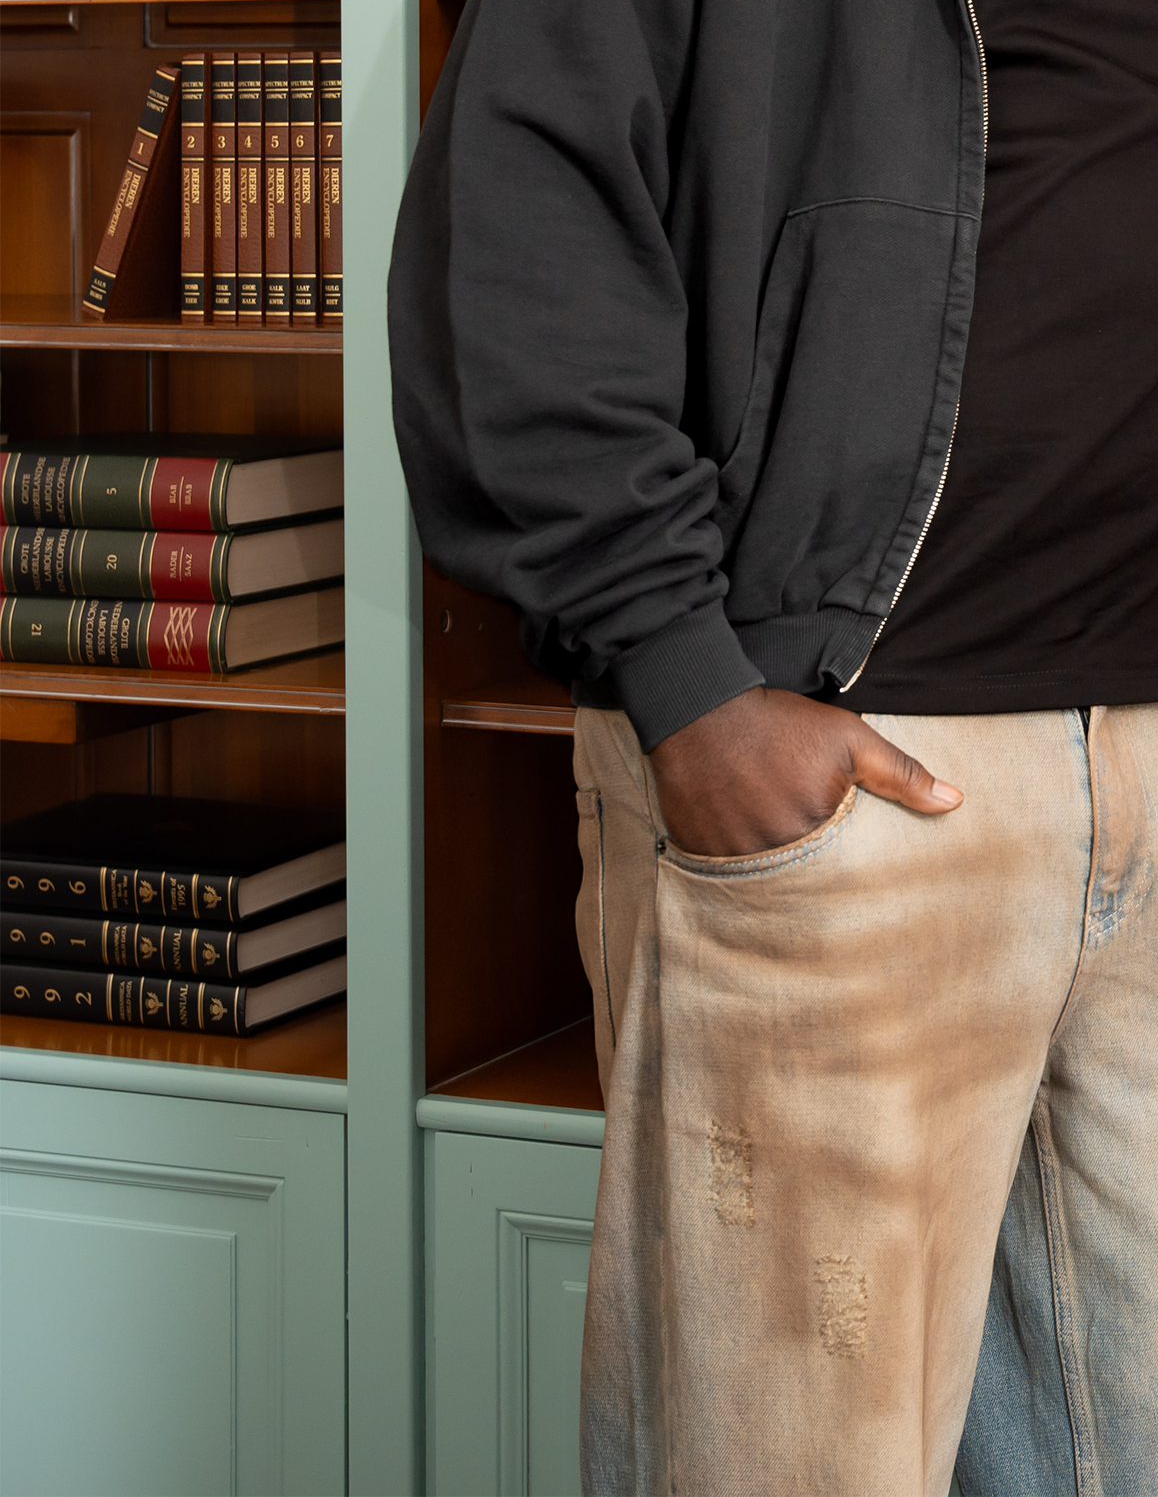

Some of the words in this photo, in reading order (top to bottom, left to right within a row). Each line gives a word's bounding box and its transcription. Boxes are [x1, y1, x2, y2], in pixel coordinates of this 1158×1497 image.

[187, 135, 195, 148] 2
[218, 136, 226, 148] 3
[244, 135, 252, 148] 4
[271, 135, 279, 148] 5
[296, 135, 304, 147] 6
[326, 134, 334, 147] 7
[191, 168, 200, 203] DIEREN
[223, 168, 231, 203] DIEREN
[107, 487, 117, 495] 5
[107, 555, 118, 570] 20
